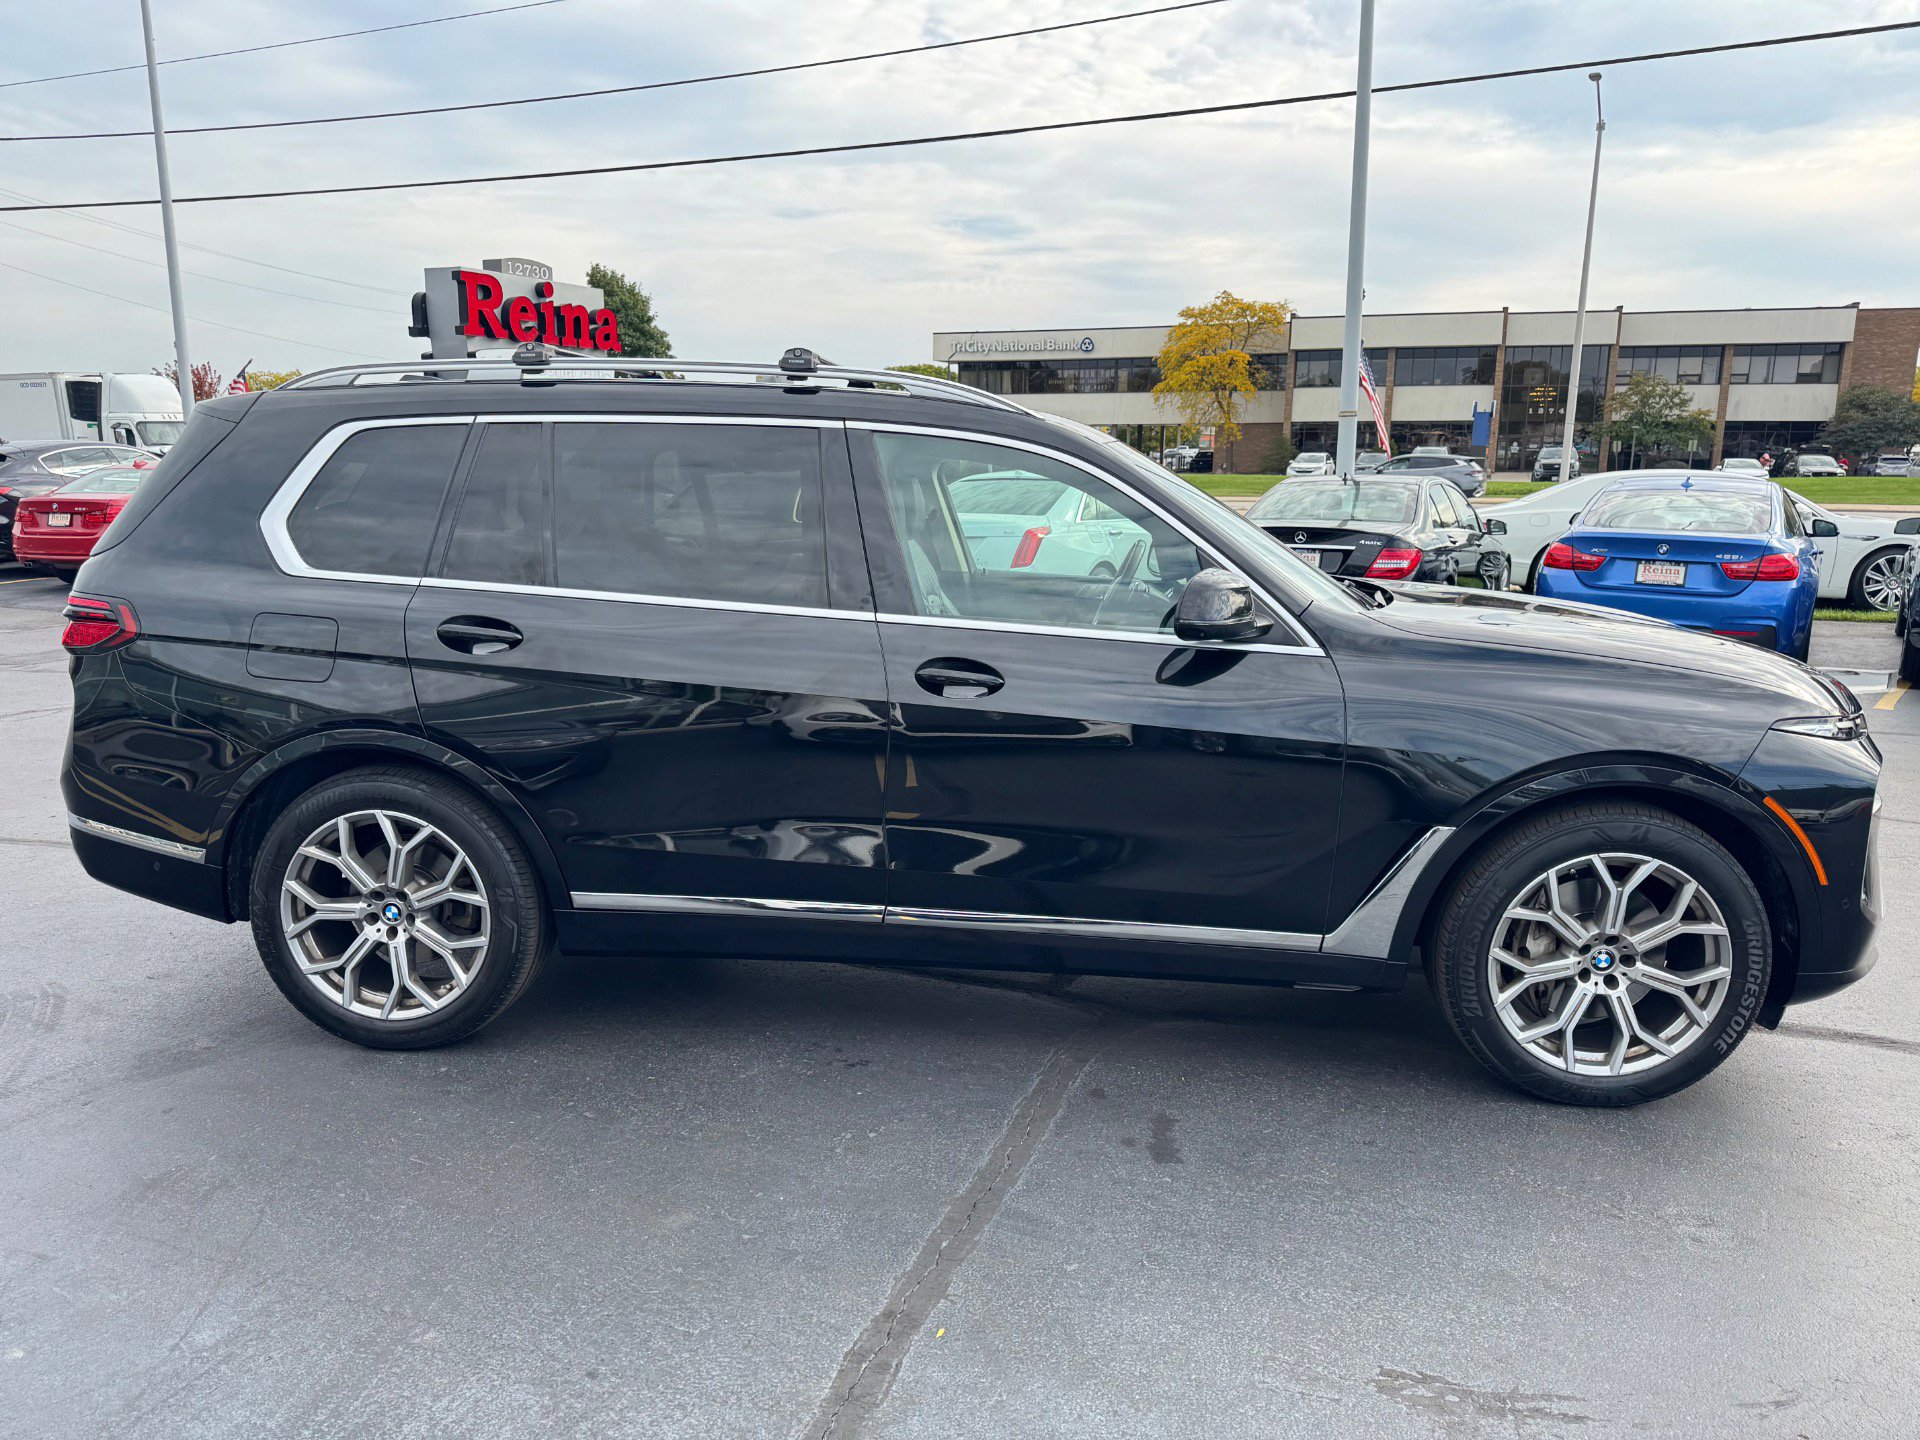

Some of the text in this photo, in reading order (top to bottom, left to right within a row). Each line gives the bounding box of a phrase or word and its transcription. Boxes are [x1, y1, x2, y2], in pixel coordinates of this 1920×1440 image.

[506, 260, 549, 280] 12730
[459, 270, 622, 352] Reina
[992, 339, 1044, 353] National
[1046, 338, 1079, 351] Bank
[1642, 564, 1681, 576] Reina
[1457, 882, 1508, 1017] BRIDGESTONE
[1713, 917, 1764, 1055] BRIDGESTONE
